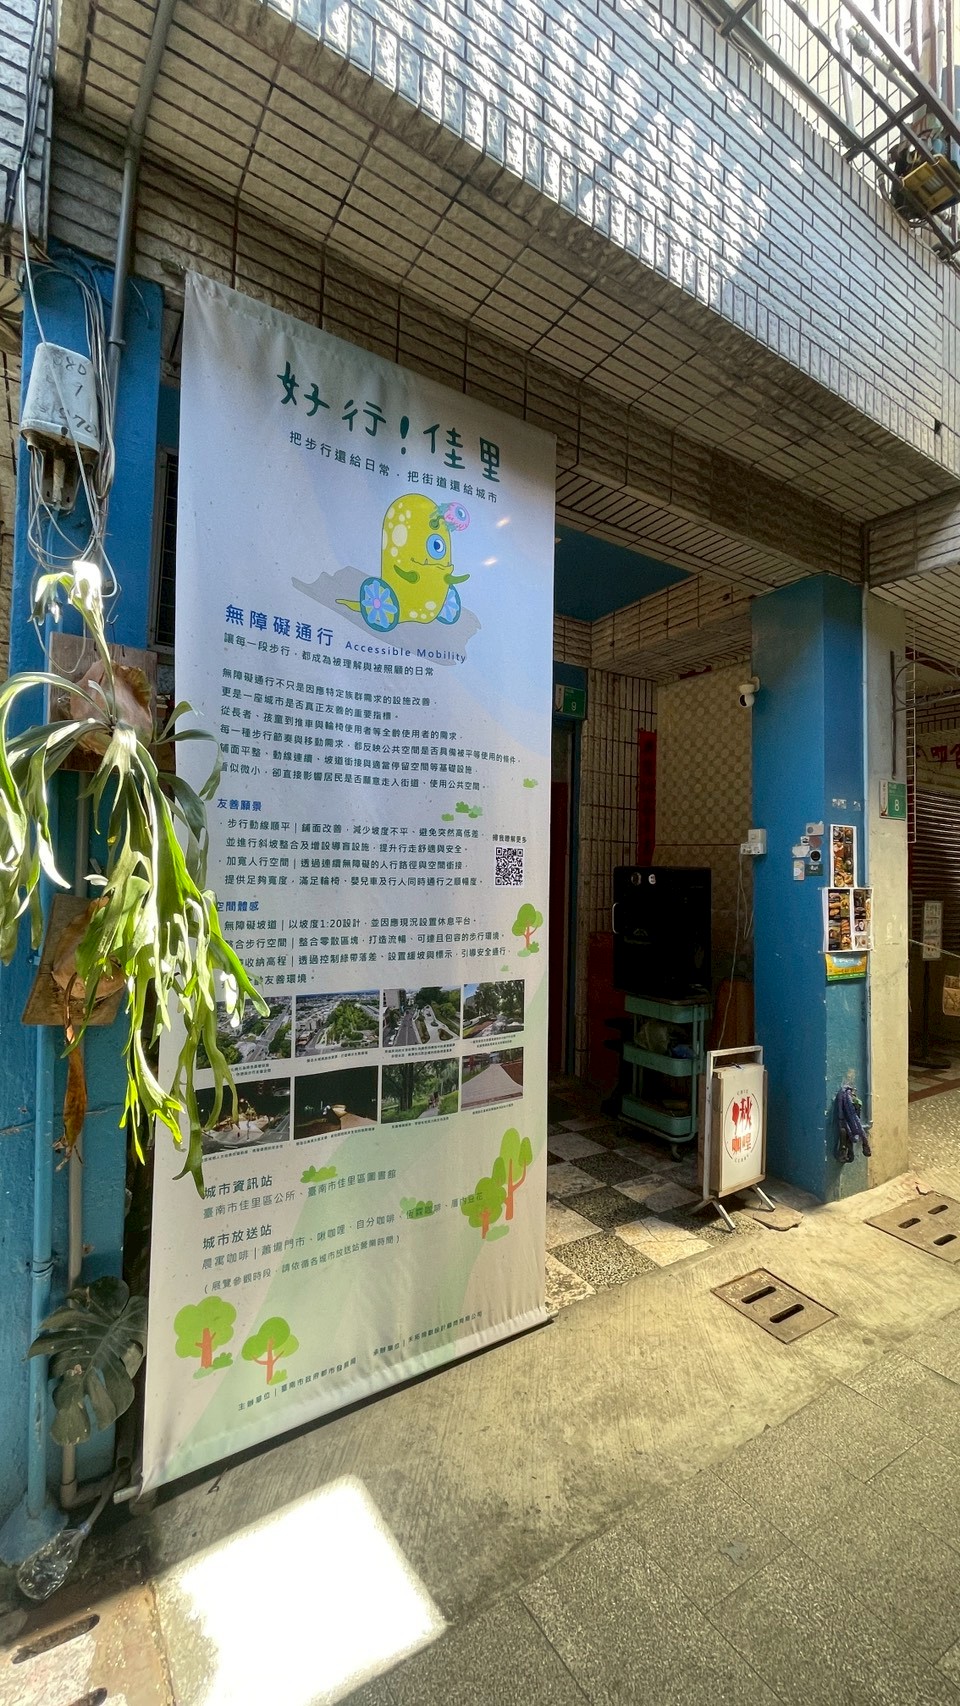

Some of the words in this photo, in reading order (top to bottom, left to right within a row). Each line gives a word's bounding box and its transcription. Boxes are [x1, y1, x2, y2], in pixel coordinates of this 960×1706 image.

[225, 604, 333, 646] 無障礙通行
[345, 641, 411, 656] Accessible
[416, 648, 466, 664] Mobility
[217, 799, 262, 811] 友善願景
[217, 901, 259, 912] 空間體感
[204, 1175, 273, 1199] 城市資訊站
[202, 1224, 272, 1250] 城市放送站
